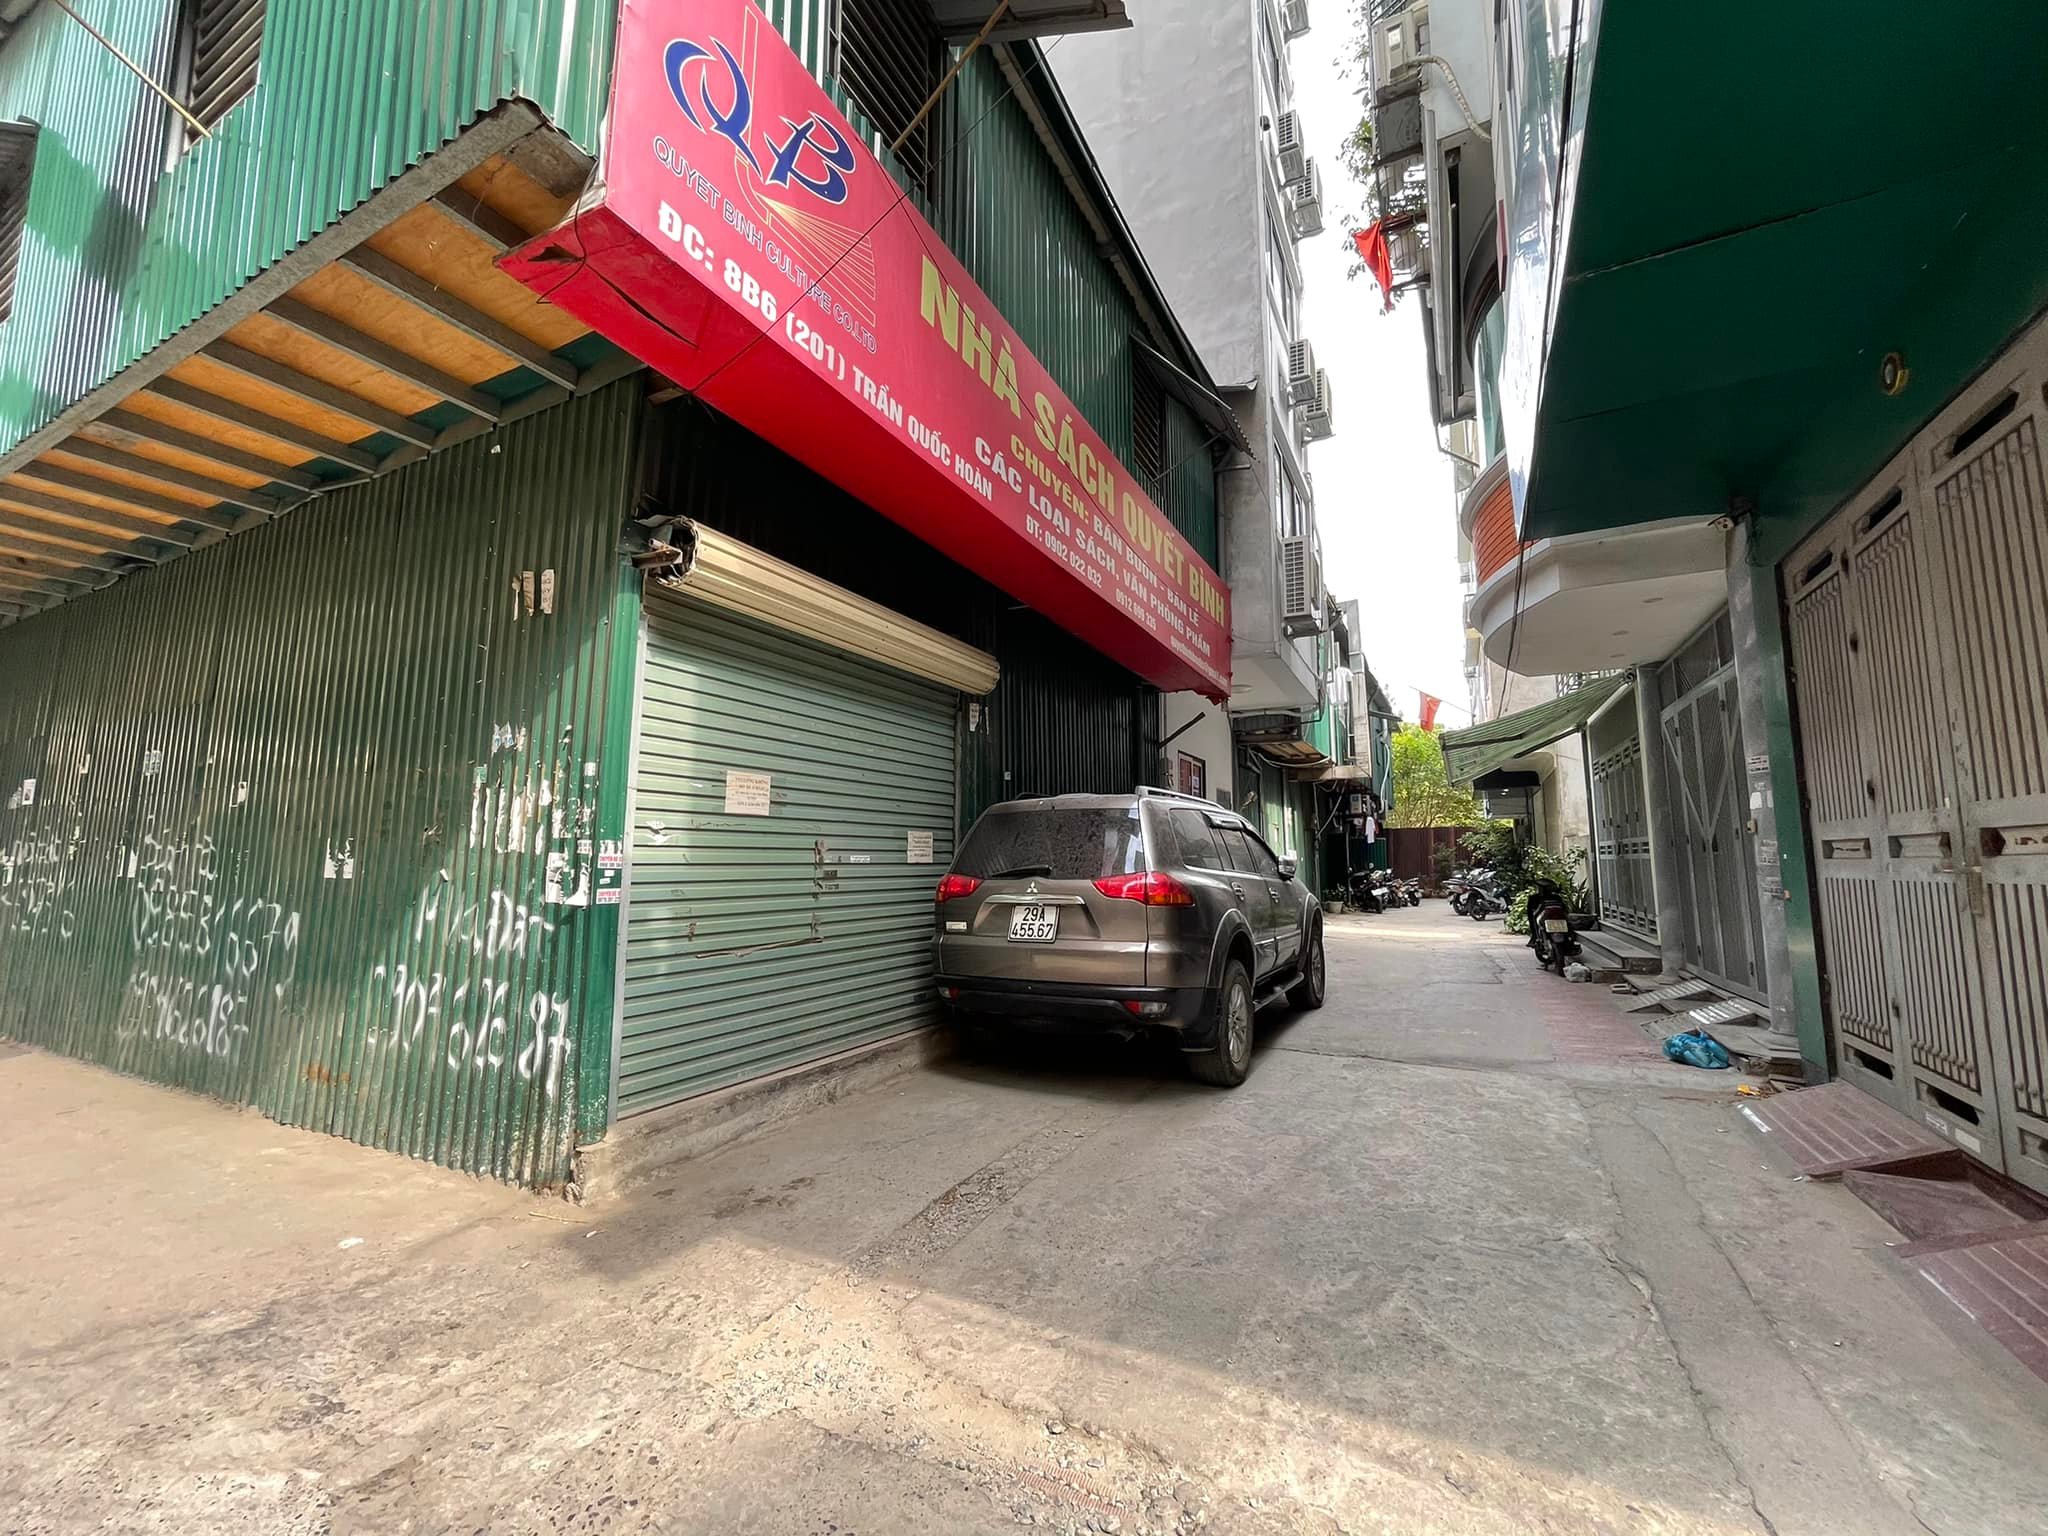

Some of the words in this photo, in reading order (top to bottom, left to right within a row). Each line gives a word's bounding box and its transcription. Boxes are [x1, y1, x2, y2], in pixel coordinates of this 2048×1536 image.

[653, 135, 721, 210] QUYET
[723, 198, 762, 251] BINH
[765, 240, 832, 315] CULTURE
[658, 200, 714, 271] ĐC:
[723, 258, 778, 322] 8B6
[785, 312, 846, 381] (201)
[852, 364, 903, 428] TRẦN
[908, 414, 951, 467] QUỐC
[954, 453, 993, 501] HOÀN
[920, 254, 1021, 419] NHÀ
[1033, 391, 1115, 517] SÁCH
[1122, 491, 1185, 587] QUYẾT
[1188, 563, 1225, 629] BÌNH
[1011, 434, 1089, 524] CHUYÊN:
[1094, 514, 1123, 556] BÁN
[975, 436, 1022, 494] CÁC
[1029, 483, 1071, 538] LOẠI
[1123, 567, 1148, 602] VĂN
[1150, 592, 1184, 636] PHÒNG
[1026, 514, 1043, 542] ĐT:
[1044, 531, 1068, 562] 0902
[1070, 551, 1086, 576] 022
[1087, 565, 1102, 588] 032
[1011, 922, 1054, 938] 455.67
[1022, 906, 1046, 922] 29A
